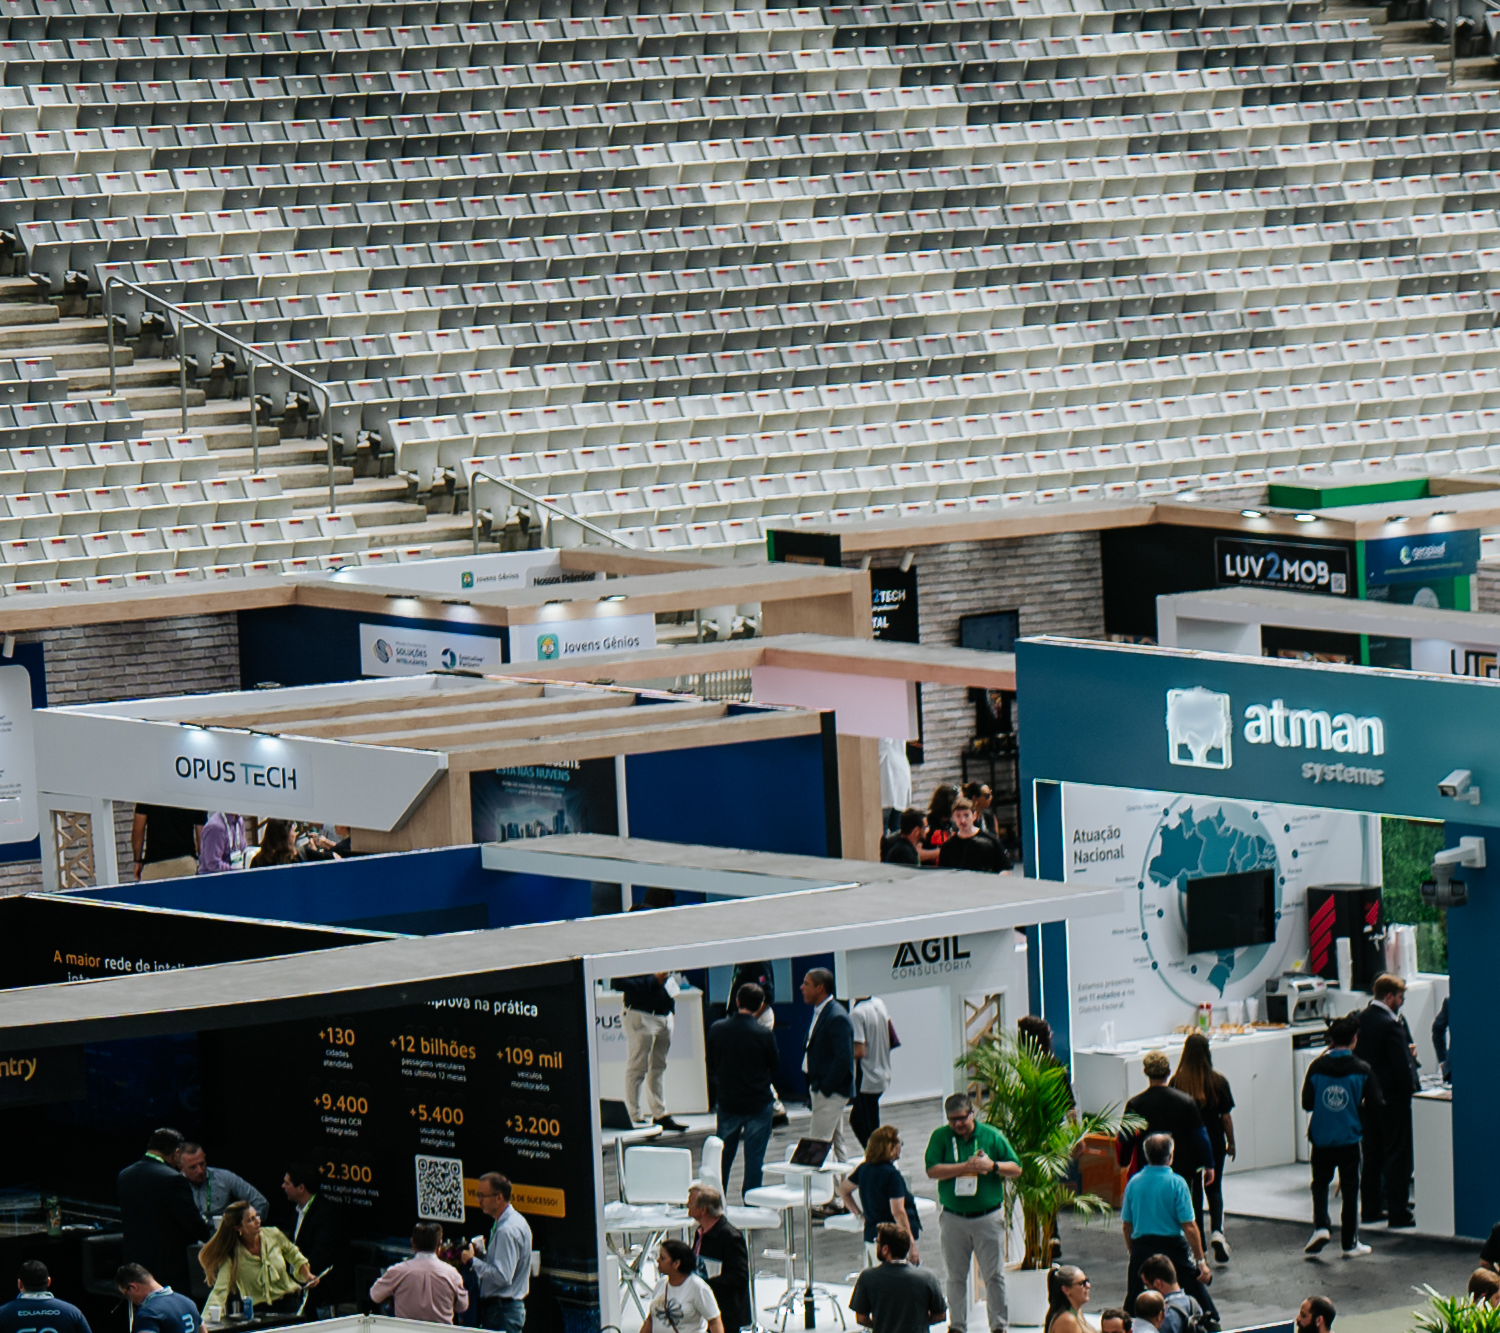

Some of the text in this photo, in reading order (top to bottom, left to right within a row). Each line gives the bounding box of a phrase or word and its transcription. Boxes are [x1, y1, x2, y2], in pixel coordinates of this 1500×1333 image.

[563, 635, 640, 654] Jovens Gênios
[1243, 698, 1386, 757] atman
[175, 755, 297, 790] OPUS TECH
[1301, 761, 1385, 786] systems
[1073, 825, 1121, 846] Atuação
[1074, 845, 1124, 865] Nacional
[892, 958, 972, 981] CONSULTORIA
[474, 999, 538, 1017] na prática
[318, 1027, 356, 1046] +130
[390, 1035, 476, 1060] +12 bilhões
[497, 1047, 563, 1069] +109 mil
[314, 1094, 368, 1115] +9.400
[409, 1104, 464, 1125] +5.400
[506, 1115, 560, 1137] +3.200
[318, 1162, 372, 1183] +2.300
